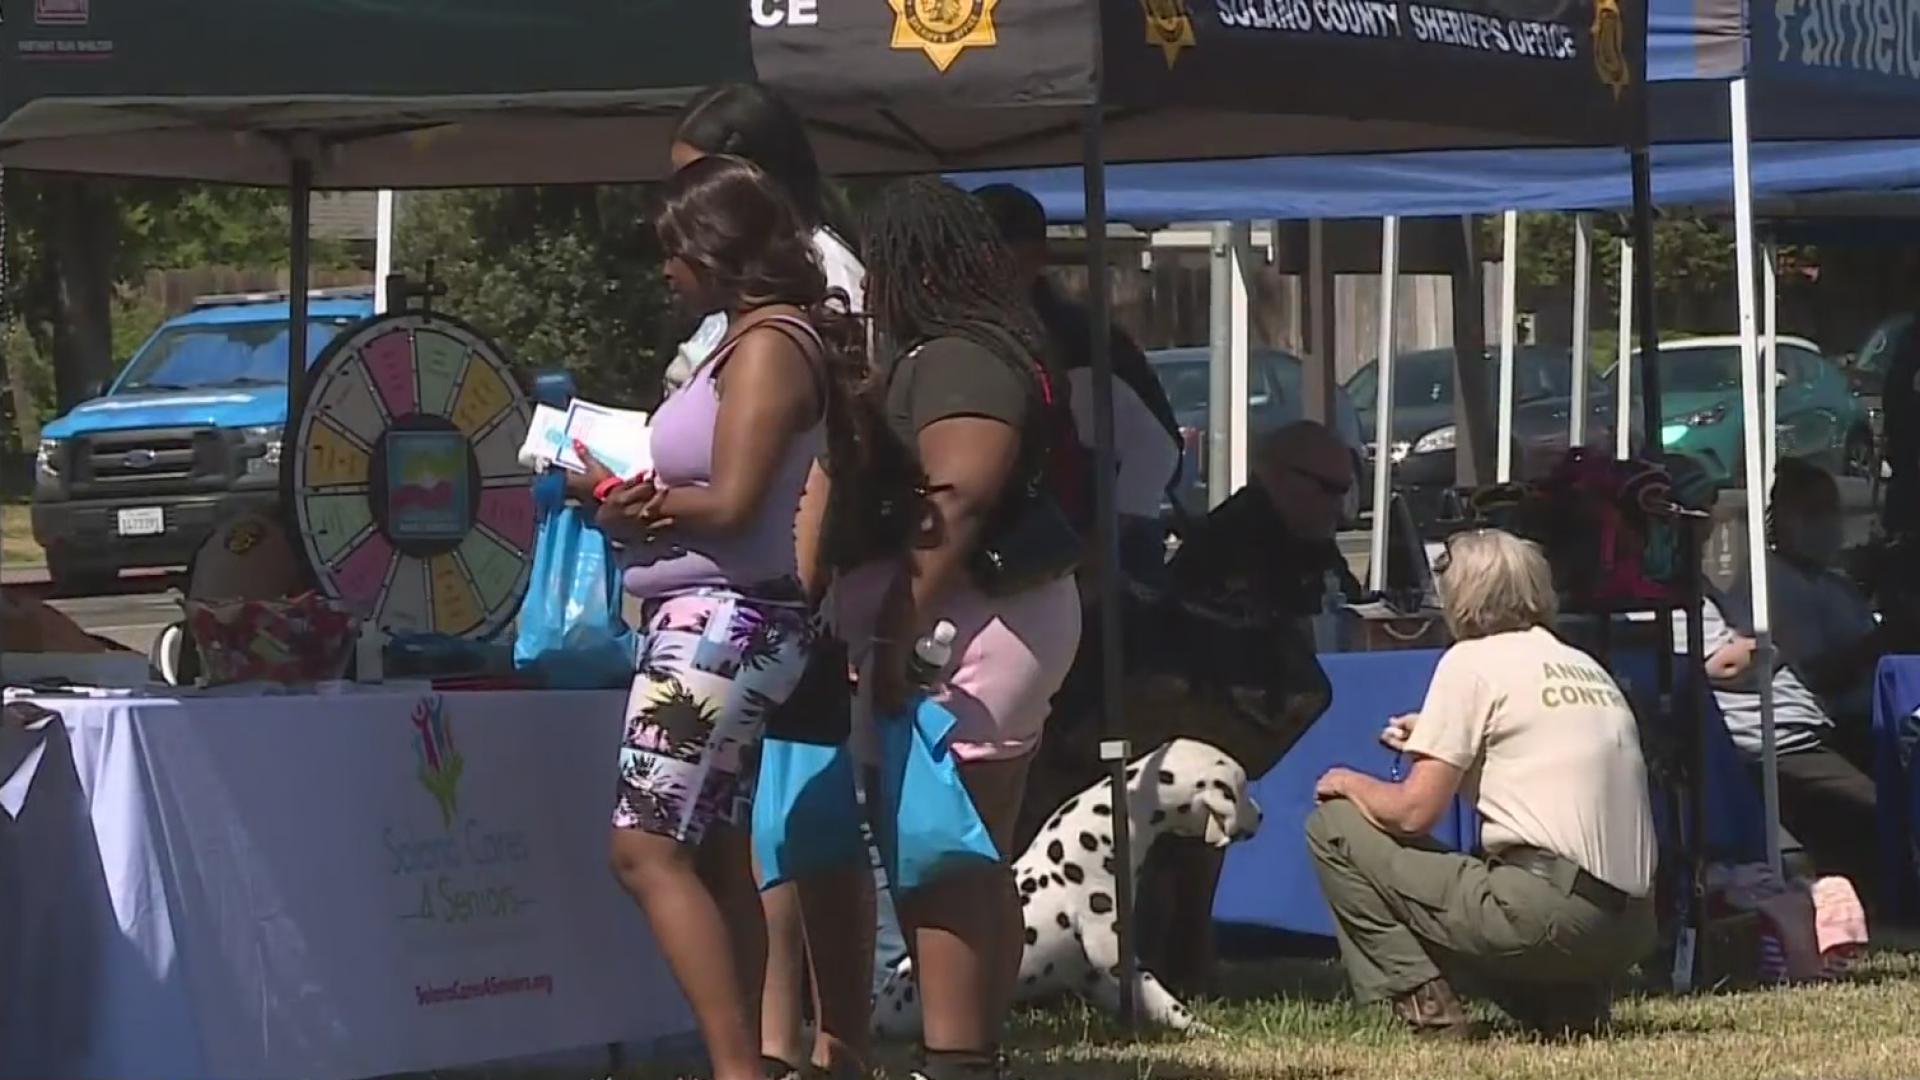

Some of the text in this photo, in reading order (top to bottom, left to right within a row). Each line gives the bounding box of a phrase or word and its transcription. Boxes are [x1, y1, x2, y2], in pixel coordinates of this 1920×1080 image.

[1217, 0, 1312, 30] SOLANO
[1312, 0, 1402, 37] COUNTY
[1508, 20, 1577, 58] OFFICE
[1542, 662, 1612, 685] ANIM
